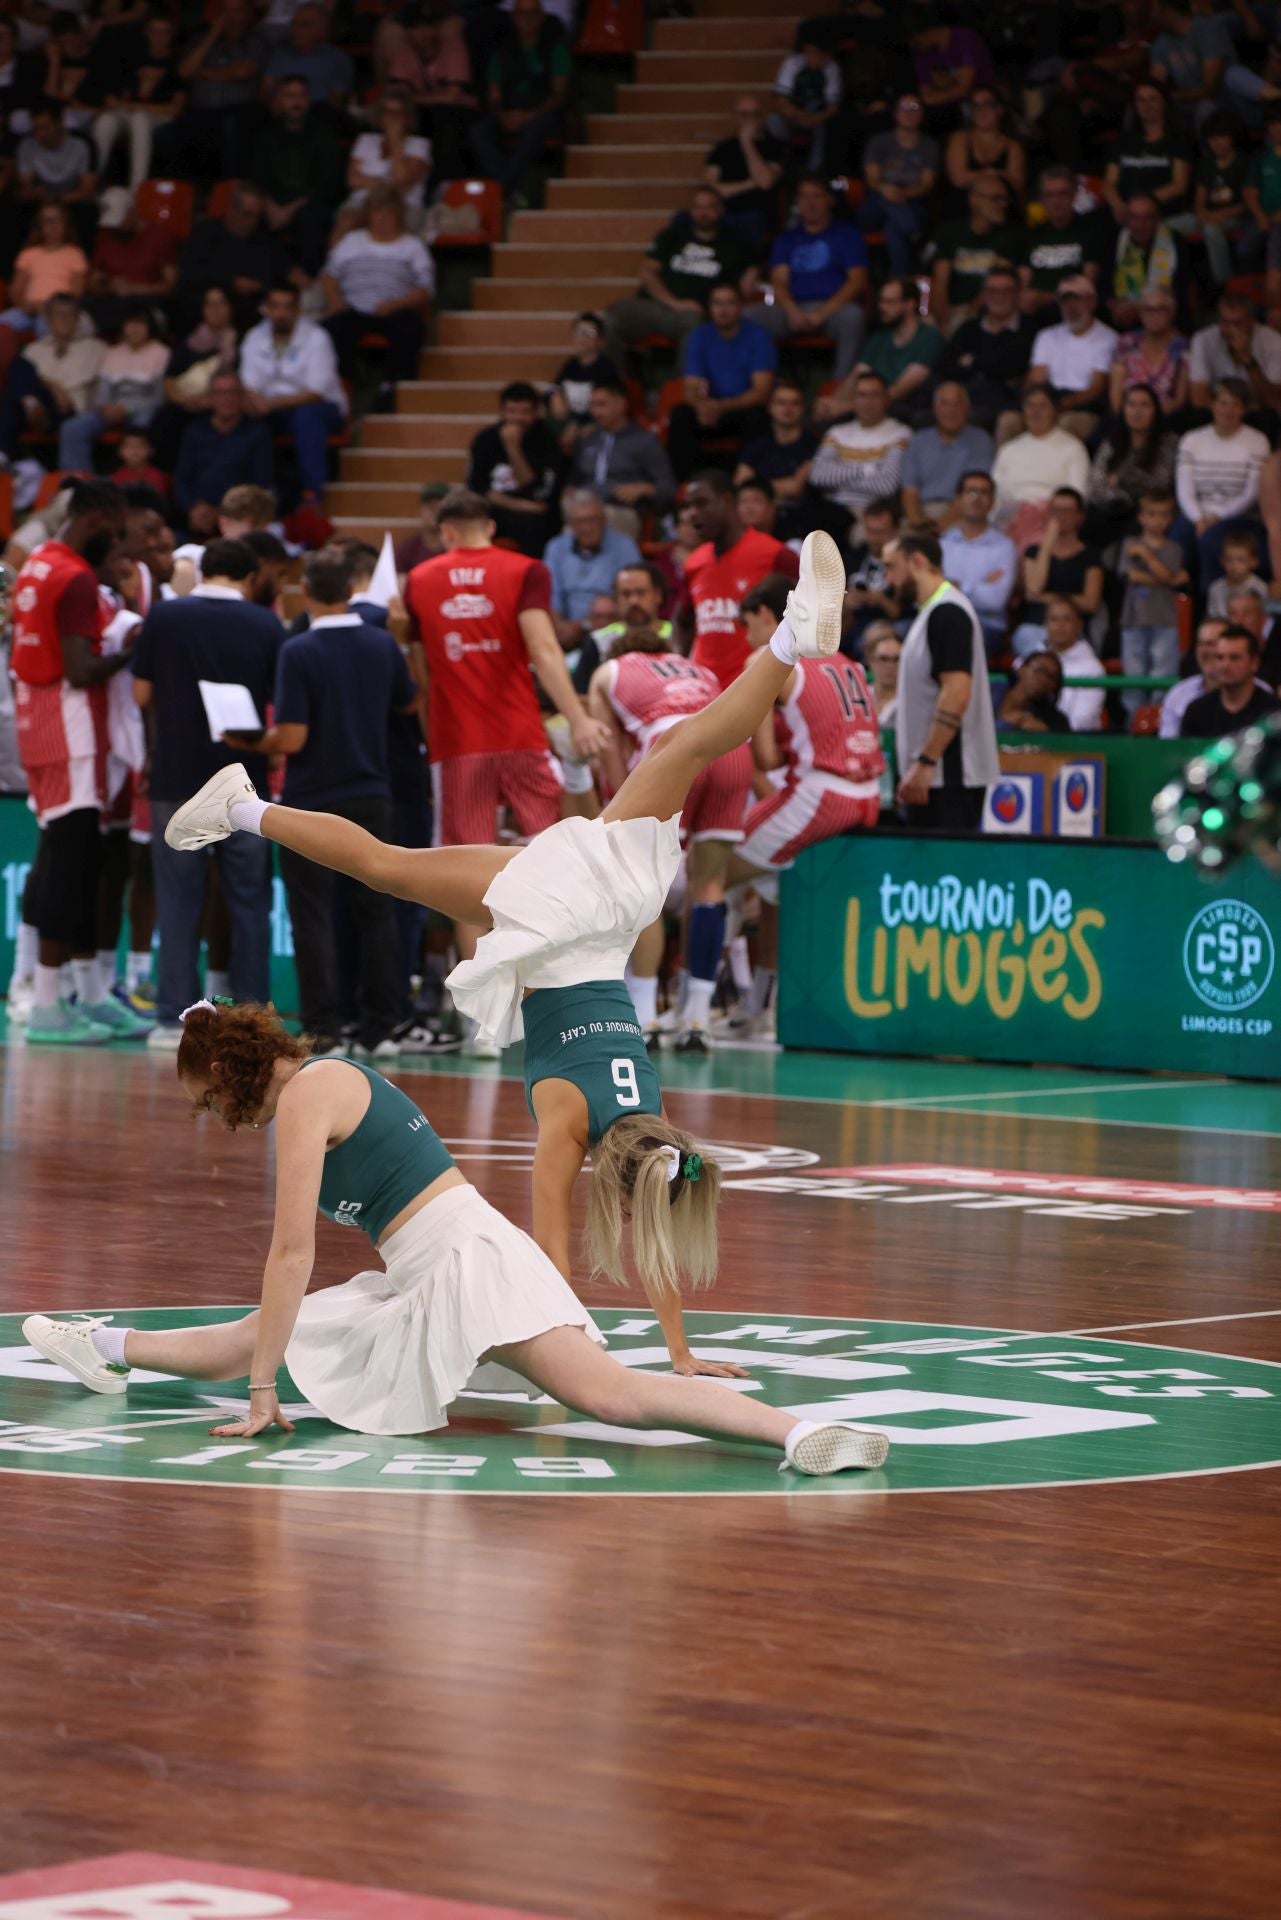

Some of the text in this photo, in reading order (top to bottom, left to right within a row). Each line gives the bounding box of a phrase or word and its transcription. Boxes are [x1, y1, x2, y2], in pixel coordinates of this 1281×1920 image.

[821, 663, 874, 722] 14
[1196, 922, 1262, 977] CSP
[560, 1025, 586, 1044] CAFÉ
[589, 1022, 603, 1033] DU
[1181, 1014, 1273, 1036] LIMOGES CSP
[408, 1118, 422, 1131] LA
[600, 1318, 1275, 1399] IMOGES
[150, 1444, 617, 1478] 1929
